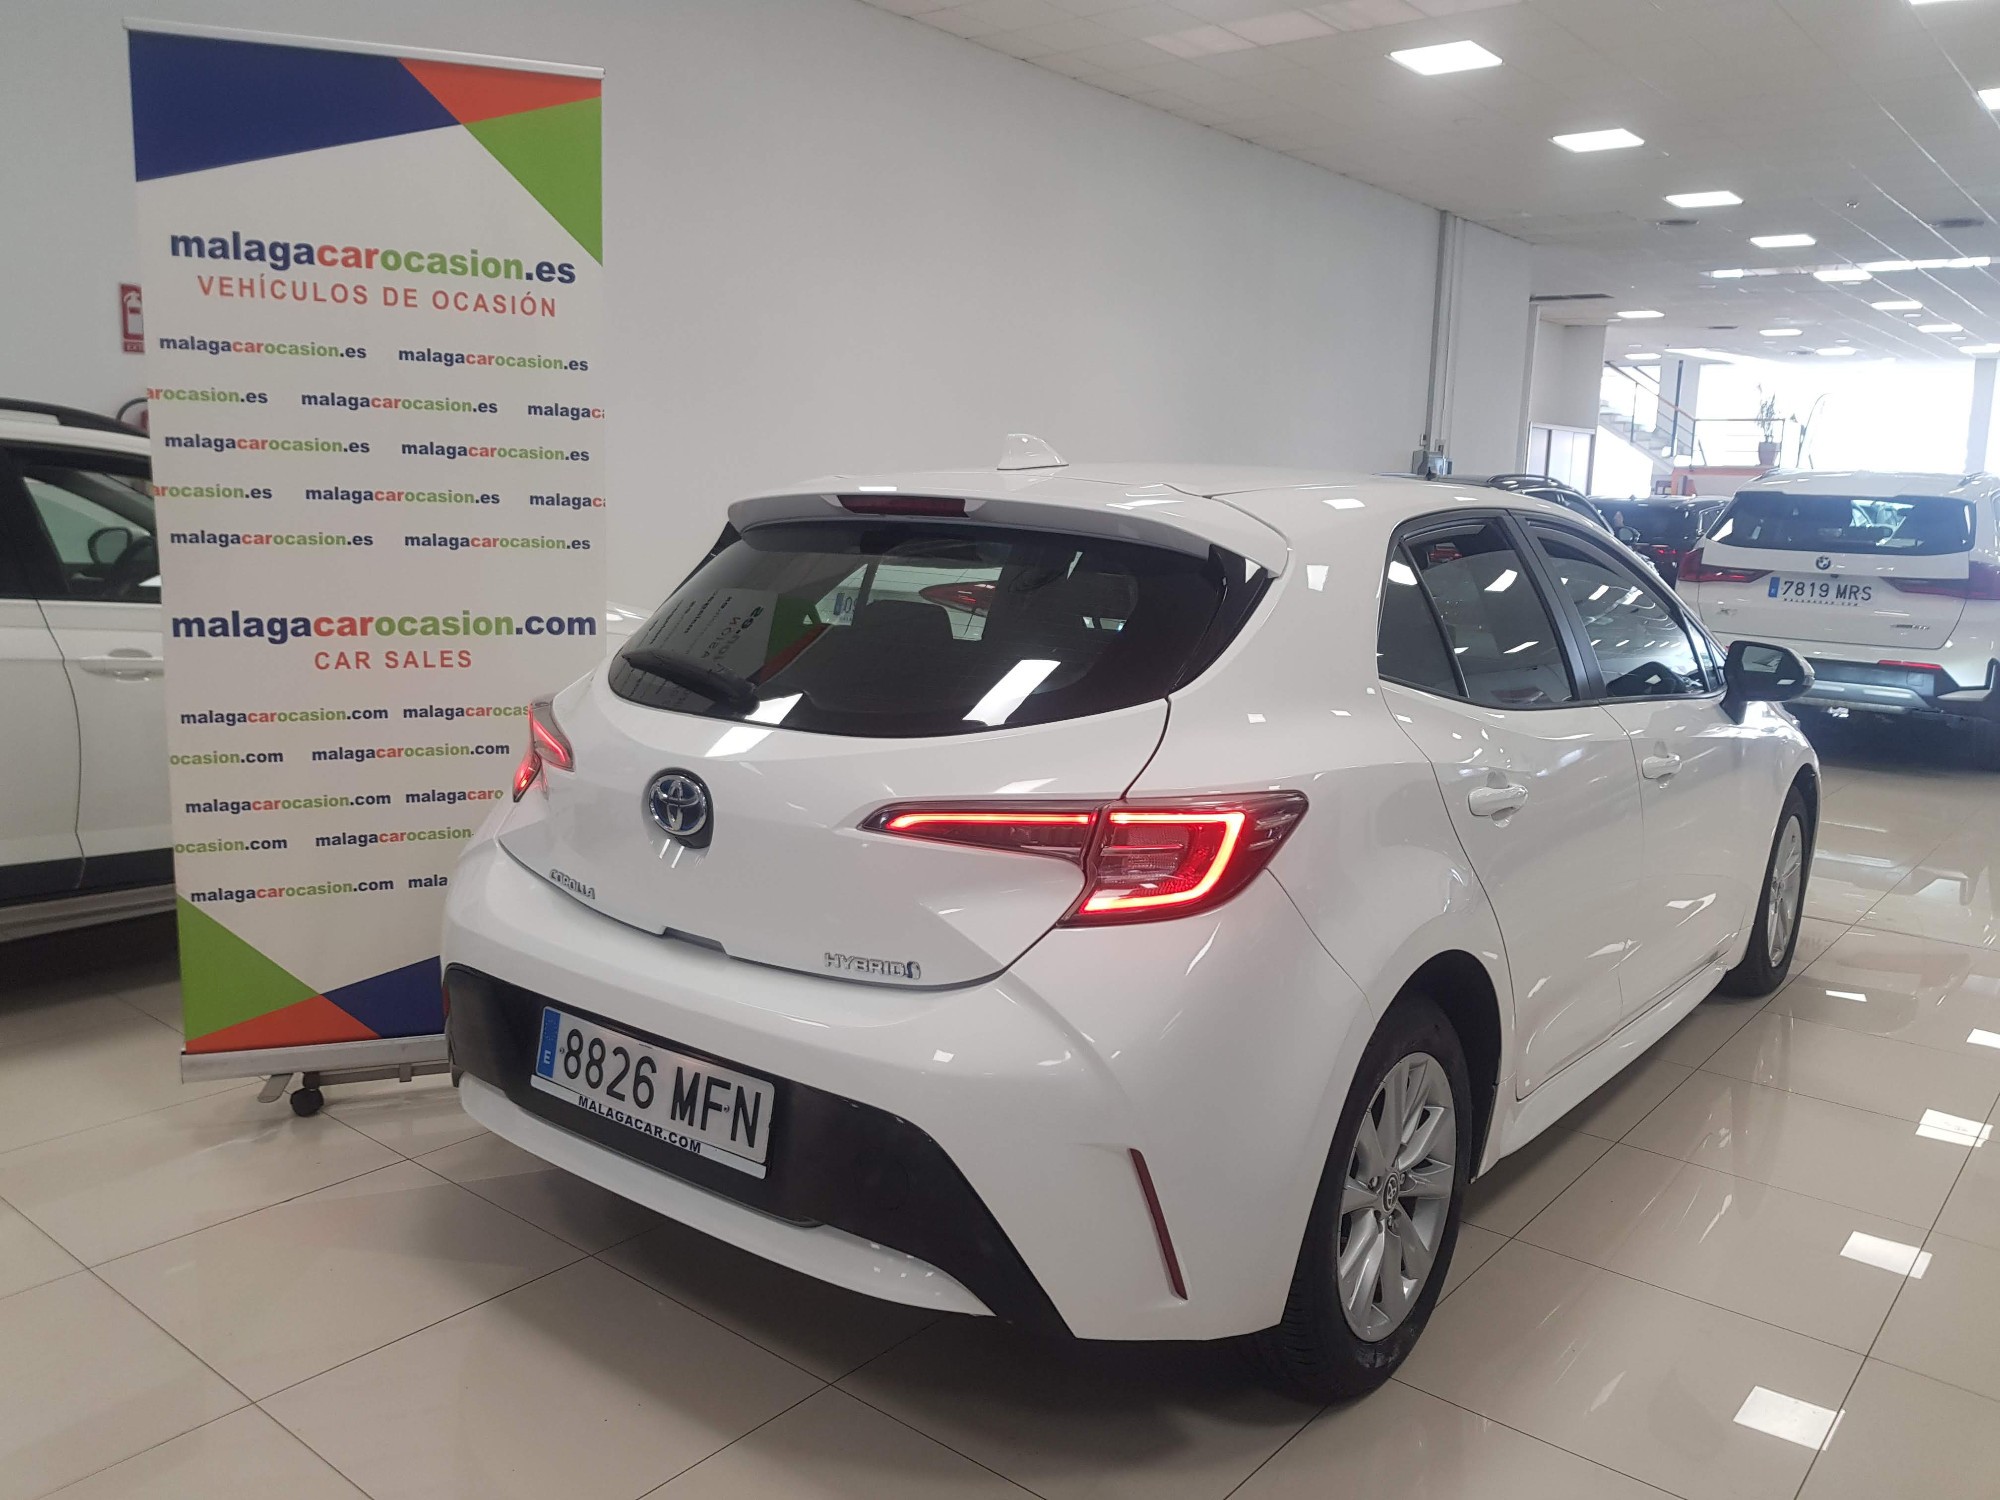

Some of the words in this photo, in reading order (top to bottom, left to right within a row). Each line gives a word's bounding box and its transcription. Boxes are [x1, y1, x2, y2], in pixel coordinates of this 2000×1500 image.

[171, 230, 576, 285] malagacarocasion.es
[198, 273, 367, 305] VEHÍCULOS
[383, 287, 417, 307] DE
[432, 290, 555, 317] OCASIÓN
[160, 336, 366, 358] malagacarocasion.es
[399, 348, 588, 371] malagacarocasion.es
[302, 392, 497, 413] malagacarocasion.es
[528, 403, 604, 421] malagac
[165, 434, 370, 453] malagacarocasion.es
[402, 442, 589, 461] malagacarocasion.es
[306, 486, 500, 504] malagacarocasion.es
[530, 493, 605, 510] malagac
[170, 530, 373, 548] malagacarocasion.es
[405, 533, 590, 550] malagacarocasion.es
[1782, 581, 1830, 598] 7819
[1836, 584, 1872, 601] MRS
[172, 610, 596, 645] malagacarocasion.com
[315, 651, 371, 670] CAR
[385, 650, 471, 669] SALES
[181, 708, 388, 726] malagacarocasion.com
[170, 751, 283, 765] ocasion.com
[312, 743, 509, 762] malagacarocasion.com
[186, 795, 391, 814] malagacarocasion.com
[406, 789, 503, 804] malagacaro
[176, 839, 287, 853] ocasion.com
[408, 874, 448, 888] mala
[190, 880, 394, 904] malagacarocasion.com
[824, 952, 906, 977] HYBRID
[543, 1050, 551, 1064] E
[563, 1029, 658, 1109] 8826
[670, 1066, 762, 1148] MFN
[578, 1095, 702, 1154] MALAGACAR.COM
